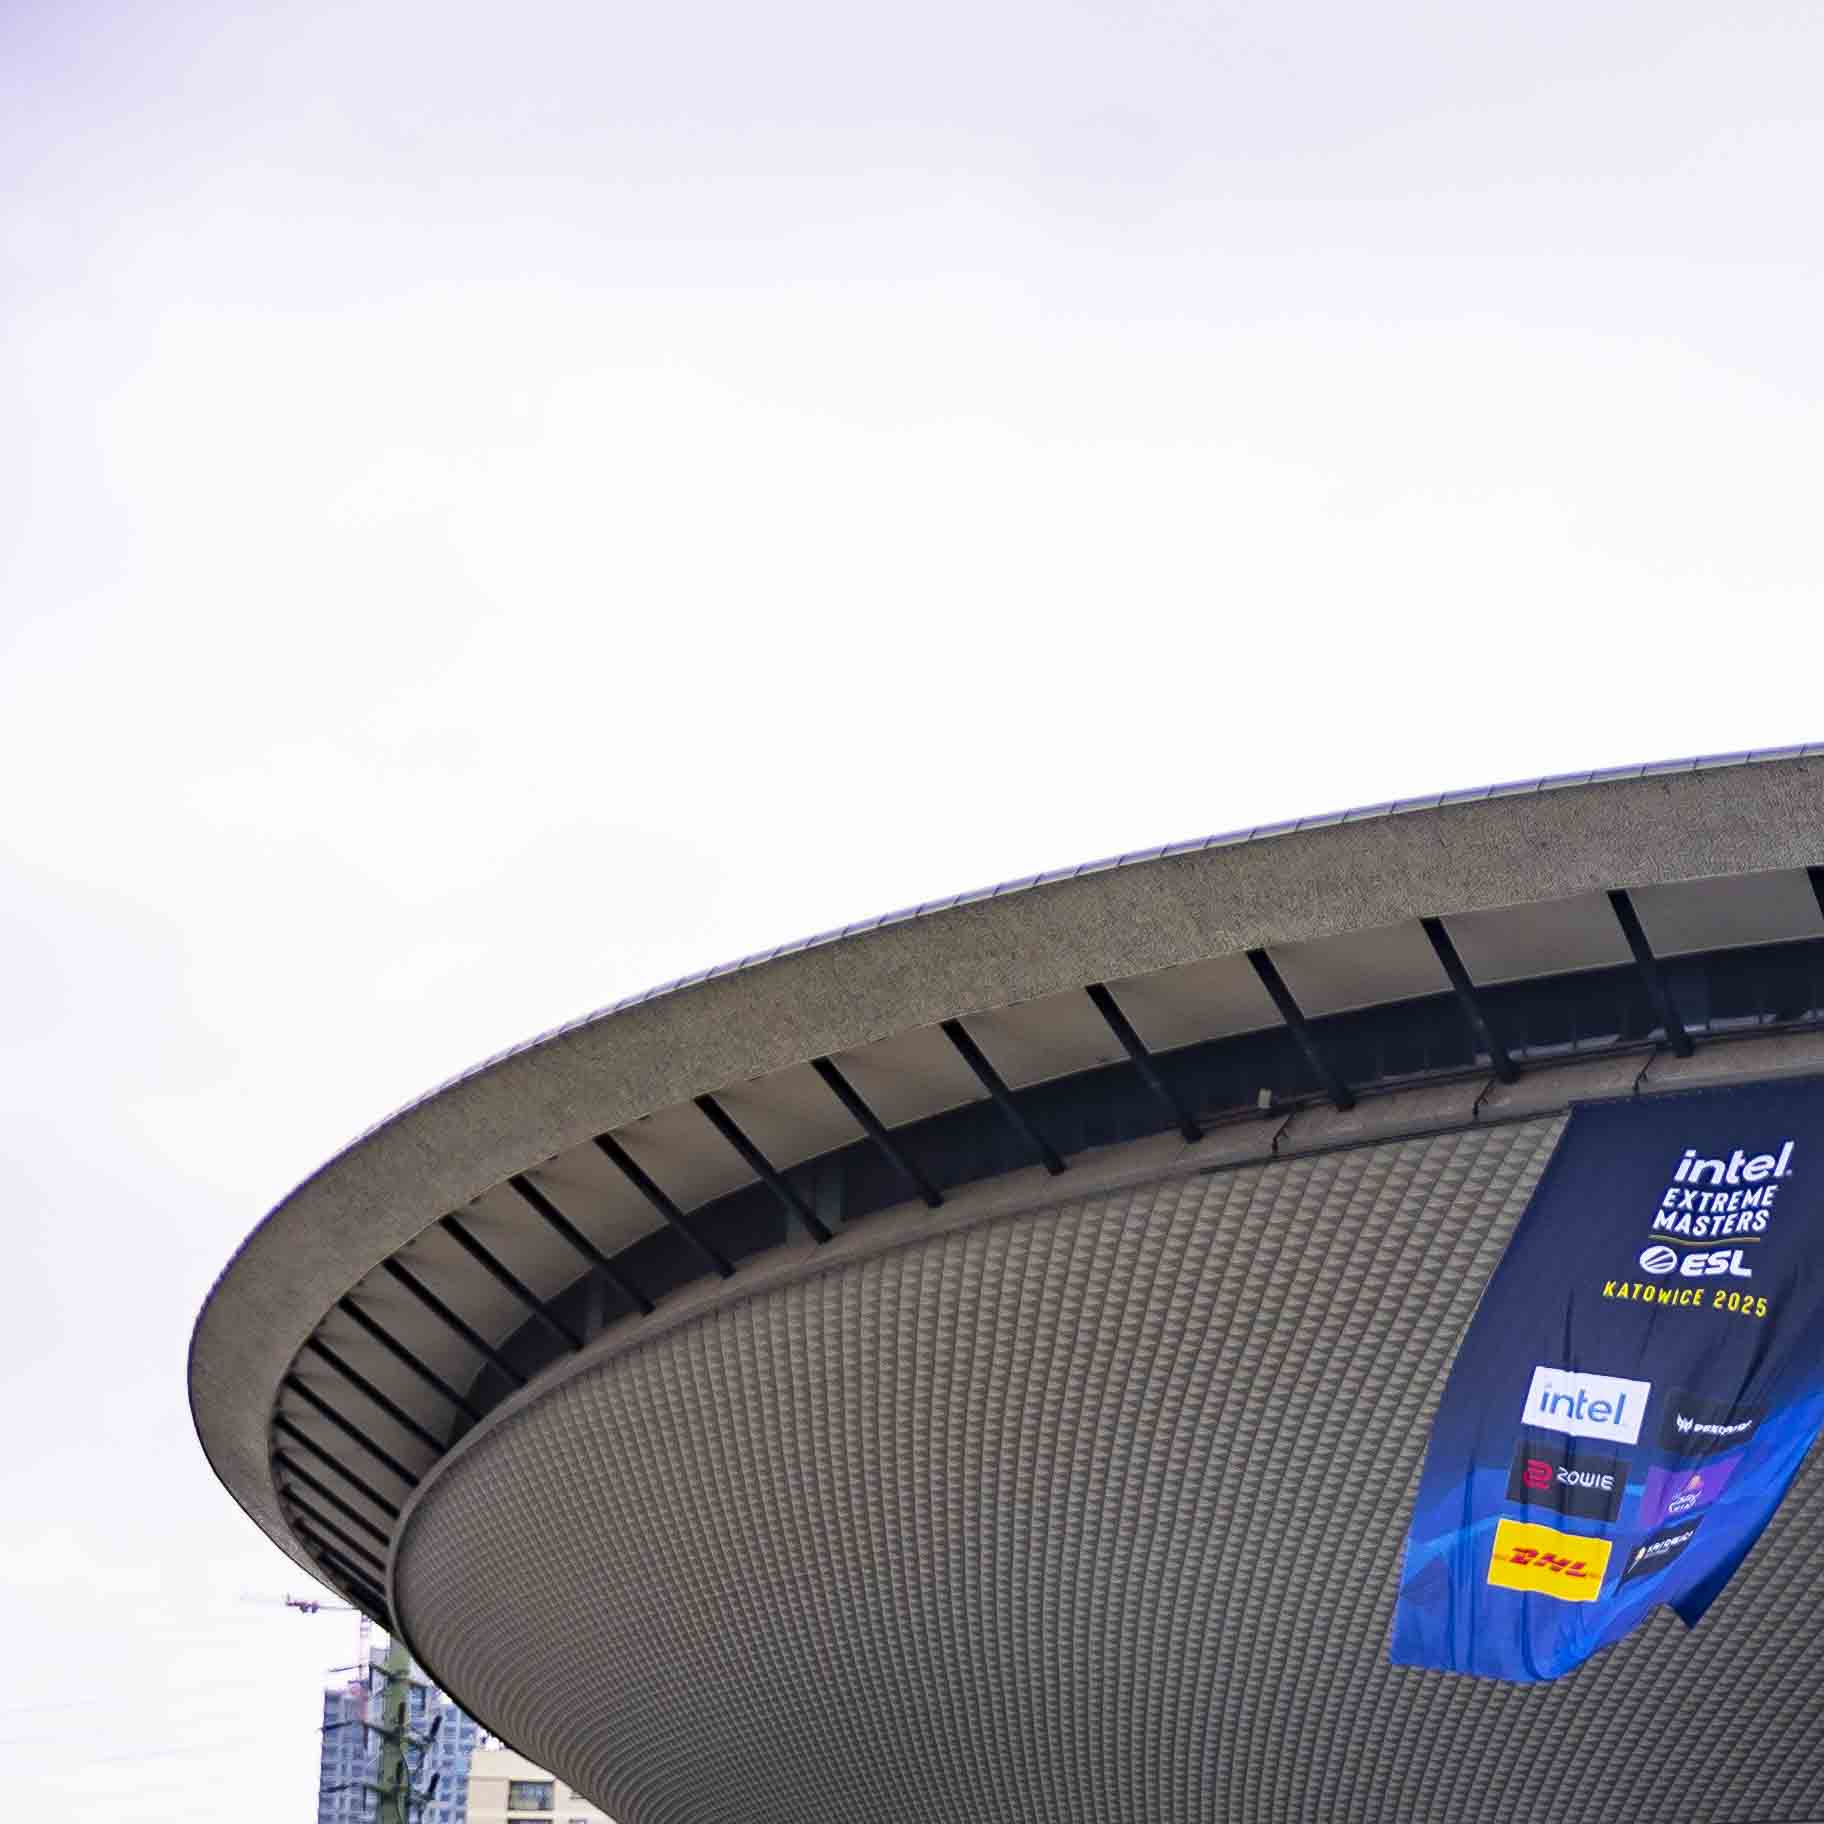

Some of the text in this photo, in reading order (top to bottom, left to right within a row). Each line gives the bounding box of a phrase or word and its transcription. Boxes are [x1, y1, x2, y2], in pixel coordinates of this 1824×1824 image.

[1661, 1184, 1779, 1213] EXTREME
[1652, 1208, 1770, 1237] MASTERS
[1679, 1249, 1753, 1278] ESL
[1602, 1280, 1769, 1318] KATOWICE 2025
[1539, 1384, 1627, 1426] intel
[1556, 1465, 1617, 1492] ZOWIE
